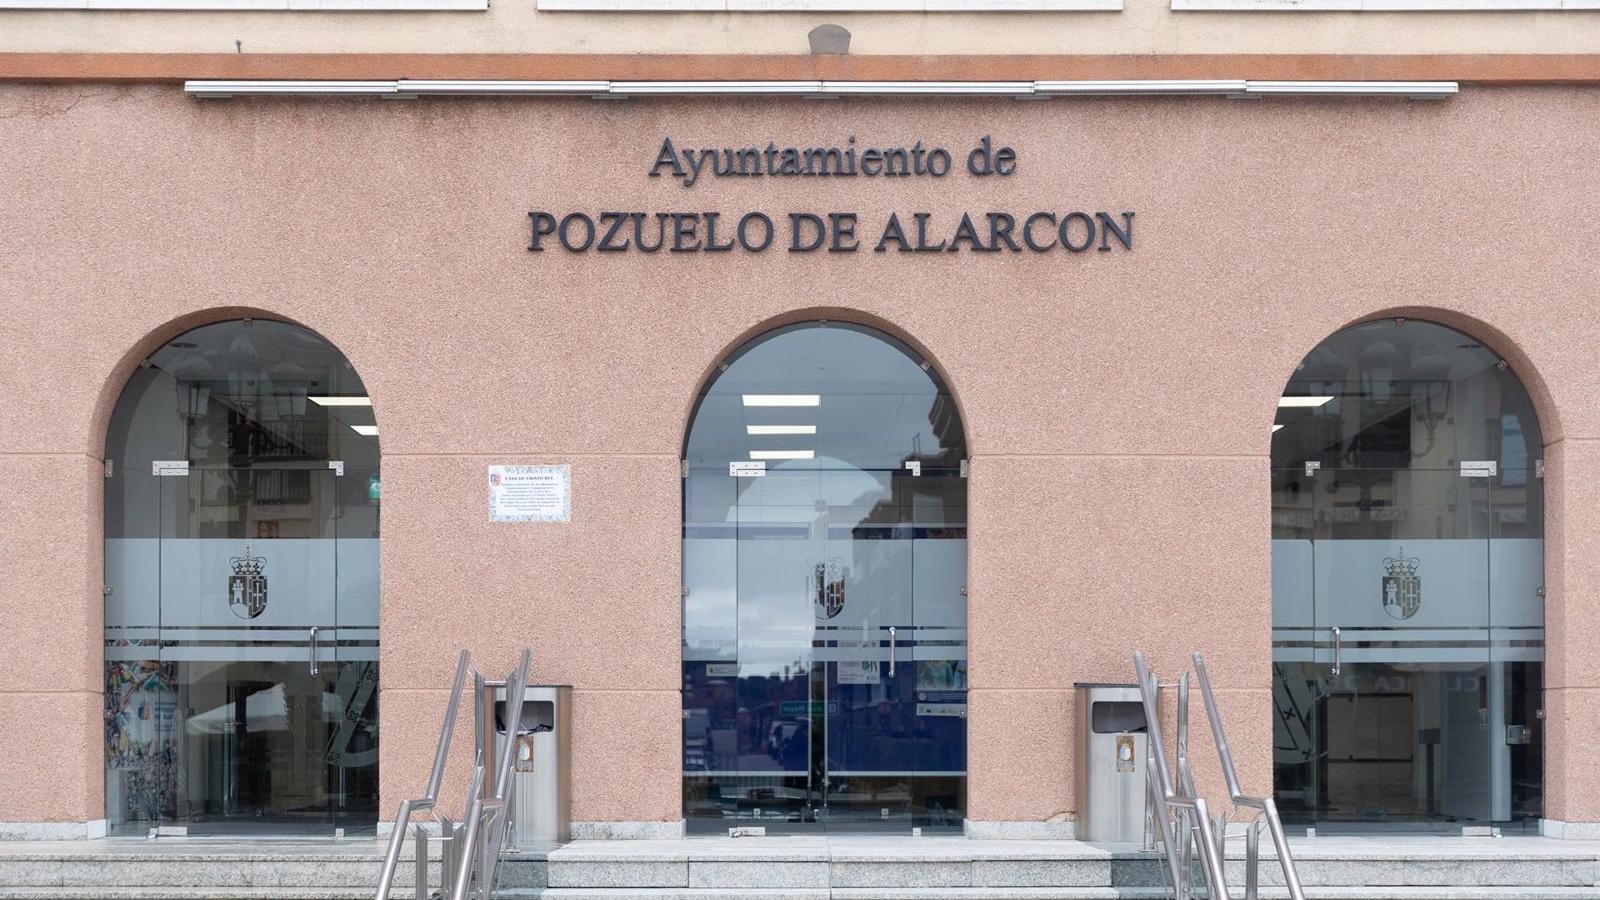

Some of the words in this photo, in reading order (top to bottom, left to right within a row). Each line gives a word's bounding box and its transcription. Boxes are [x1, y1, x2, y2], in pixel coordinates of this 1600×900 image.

[649, 135, 952, 186] Ayuntamiento
[967, 135, 1016, 176] de
[528, 211, 774, 252] POZUELO
[788, 212, 860, 252] DE
[874, 211, 1135, 252] ALARCON
